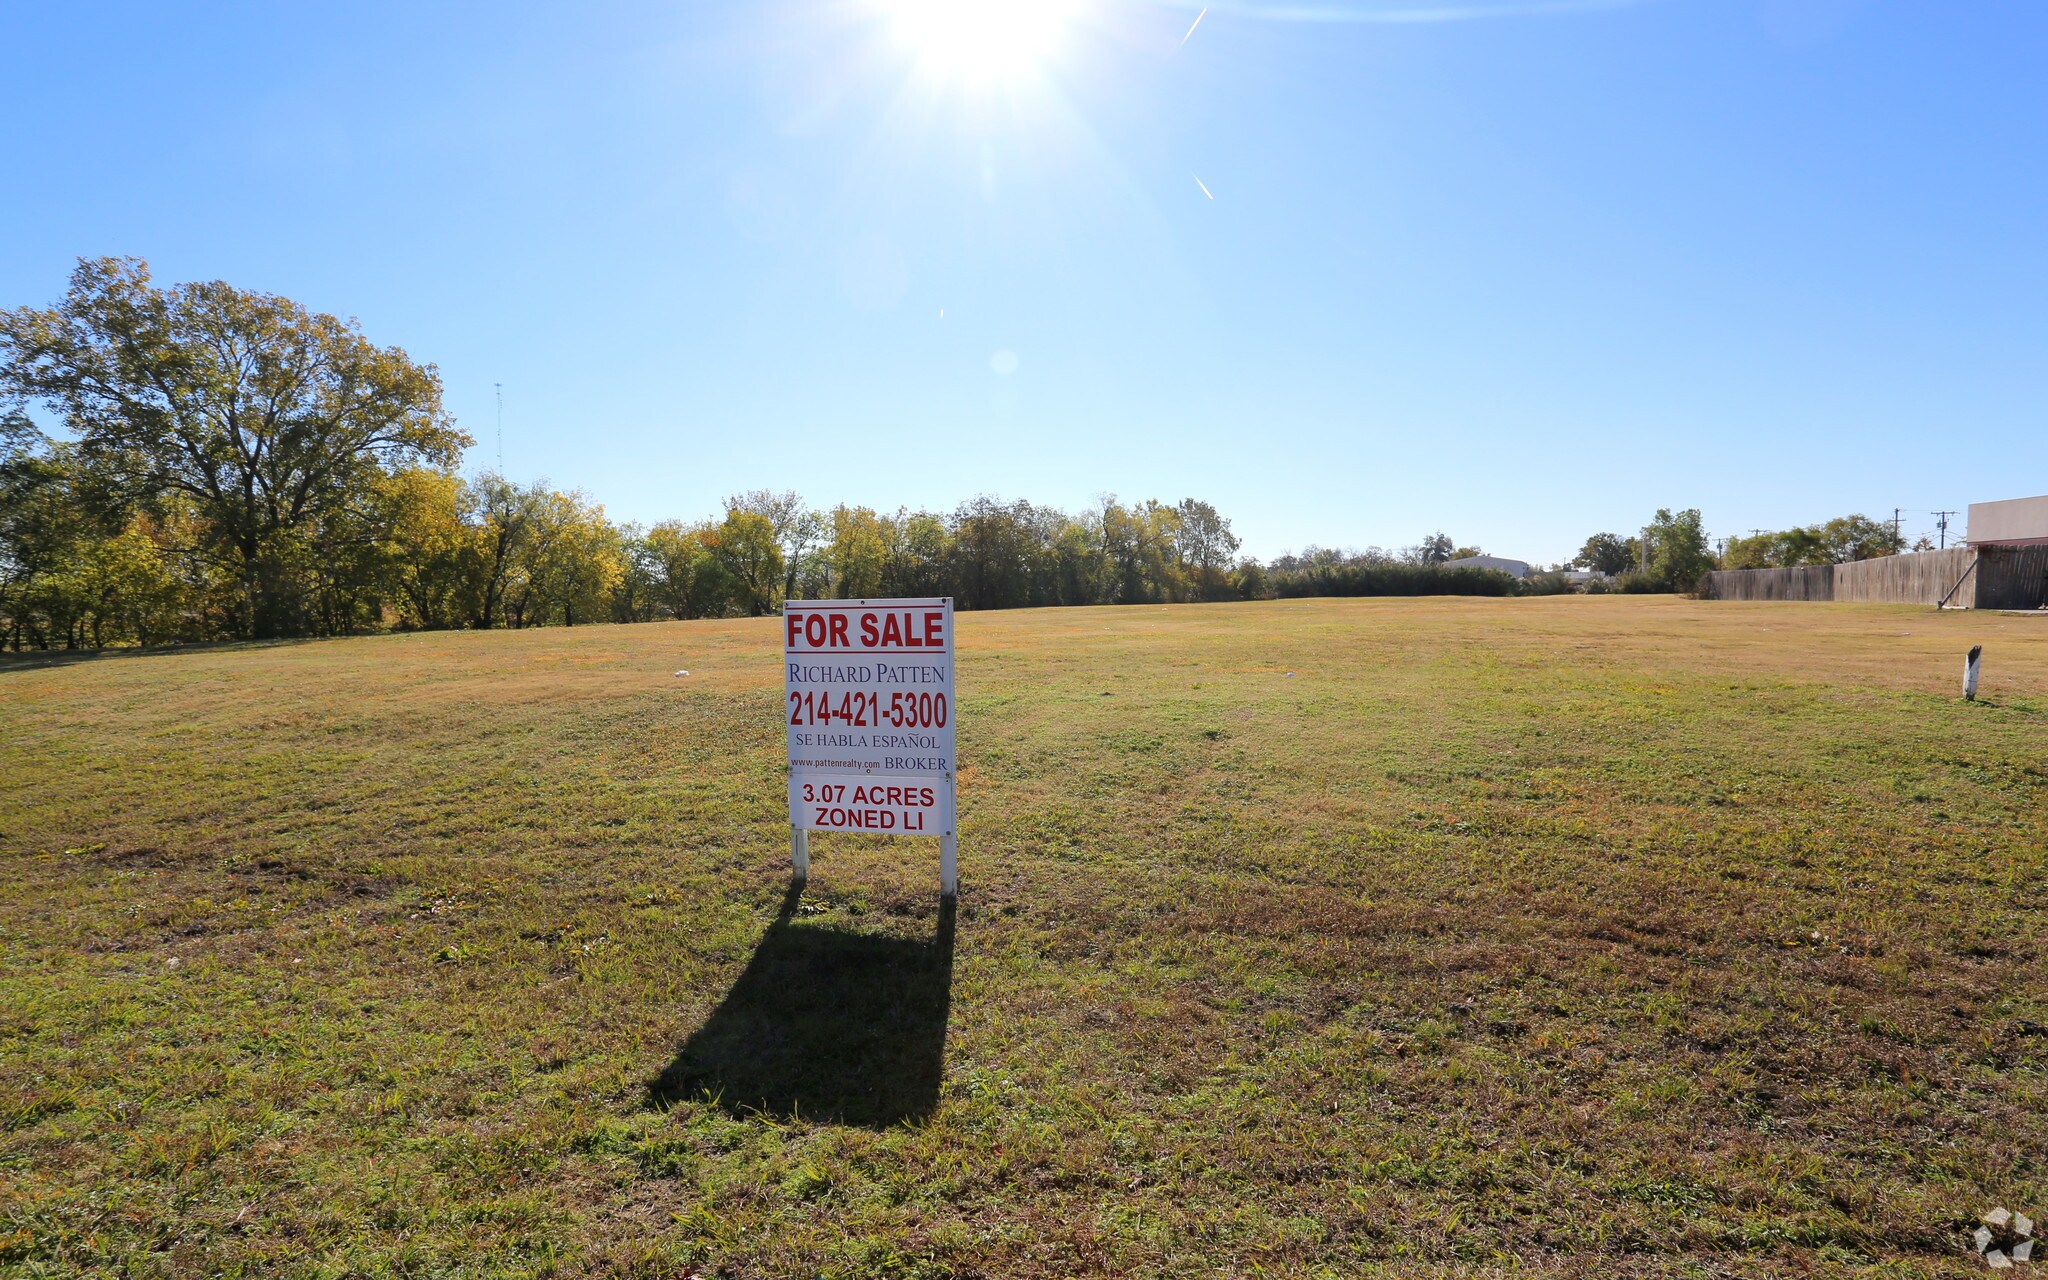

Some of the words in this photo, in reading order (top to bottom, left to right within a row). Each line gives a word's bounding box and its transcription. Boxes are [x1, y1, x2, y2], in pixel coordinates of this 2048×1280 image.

[787, 613, 851, 648] FOR
[860, 612, 944, 648] SALE
[788, 663, 871, 683] RICHARD
[876, 663, 945, 683] PATTEN
[790, 691, 947, 728] 214-421-5300
[796, 733, 813, 746] SE
[817, 734, 868, 748] HABLA
[872, 732, 941, 749] ESPAÑOL
[791, 758, 880, 770] www.pattenrealty.com
[885, 756, 948, 771] BROKER
[803, 783, 846, 803] 3.07
[852, 785, 935, 807] ACRES
[815, 807, 896, 829] ZONED
[904, 811, 923, 831] LI
